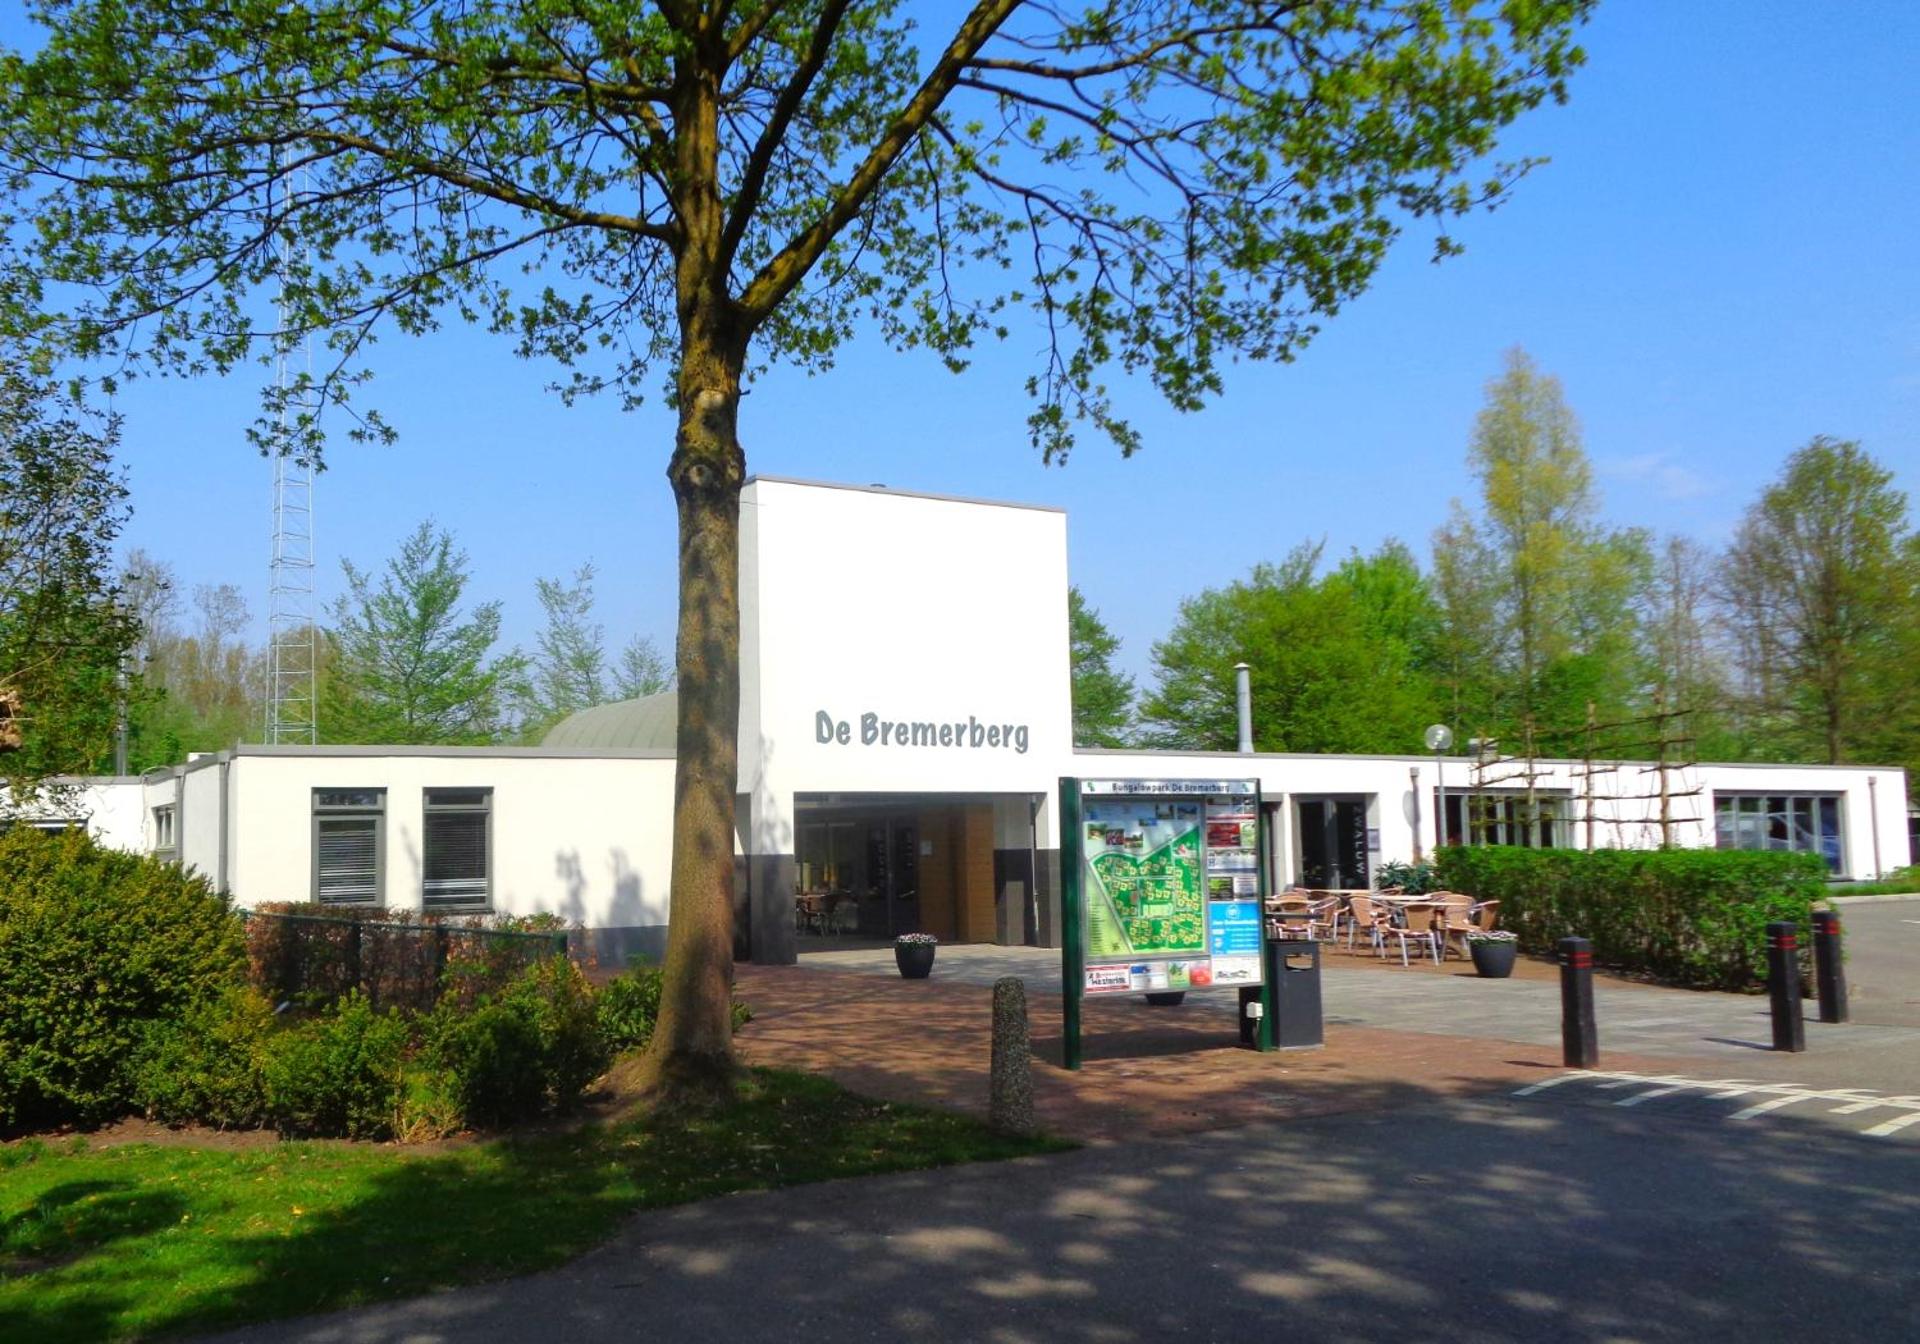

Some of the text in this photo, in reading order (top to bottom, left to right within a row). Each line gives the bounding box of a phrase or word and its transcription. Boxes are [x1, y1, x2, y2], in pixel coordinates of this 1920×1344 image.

[815, 709, 1030, 755] De Bremerberg
[1112, 782, 1169, 793] Bungalowpark
[1183, 782, 1230, 793] Bremerberg
